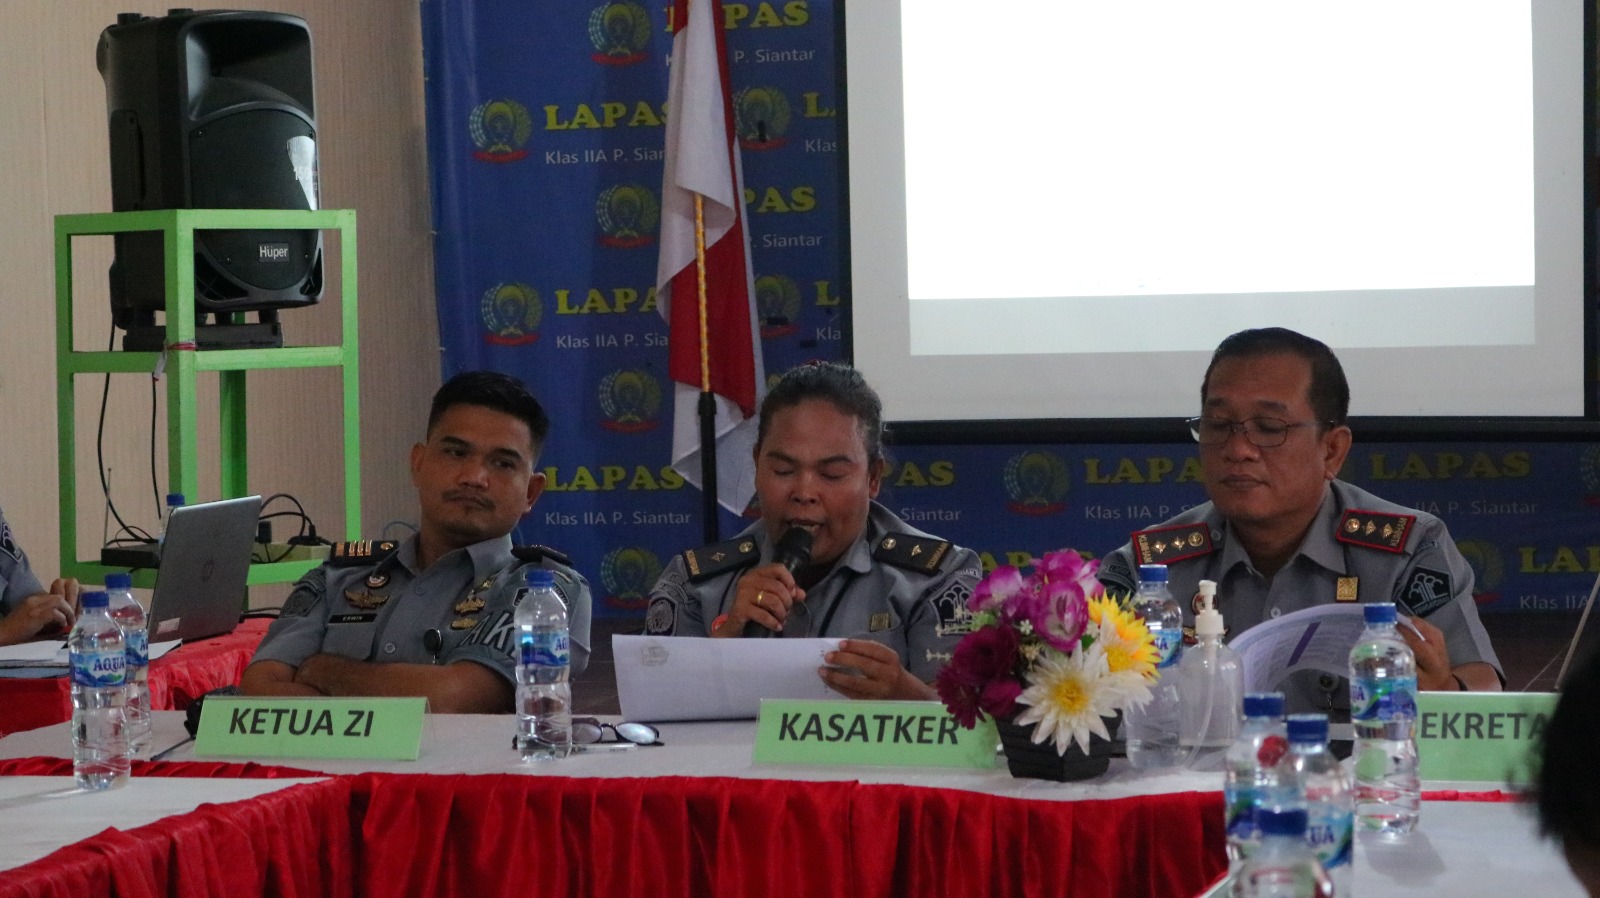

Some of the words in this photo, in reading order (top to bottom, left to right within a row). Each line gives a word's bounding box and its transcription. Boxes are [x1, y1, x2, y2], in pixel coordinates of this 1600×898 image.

[756, 49, 816, 62] Siantar
[545, 150, 579, 164] Klas
[763, 234, 822, 248] Siantar
[259, 245, 288, 260] Hüper
[554, 286, 658, 315] LAPA
[816, 327, 841, 341] Kla
[556, 335, 590, 349] Klas
[1084, 456, 1204, 484] LAPA
[1369, 451, 1531, 480] LAPAS
[543, 464, 685, 492] LAPAS
[901, 507, 962, 521] Siantar
[1085, 504, 1121, 519] Klas
[1470, 500, 1538, 515] Siantar
[545, 512, 578, 526] Klas
[633, 510, 691, 525] Siantar
[1520, 595, 1559, 610] Klas
[229, 707, 334, 736] KETUA
[343, 710, 374, 737] ZI
[778, 712, 960, 745] KASATKER
[1419, 711, 1548, 740] EKRETA
